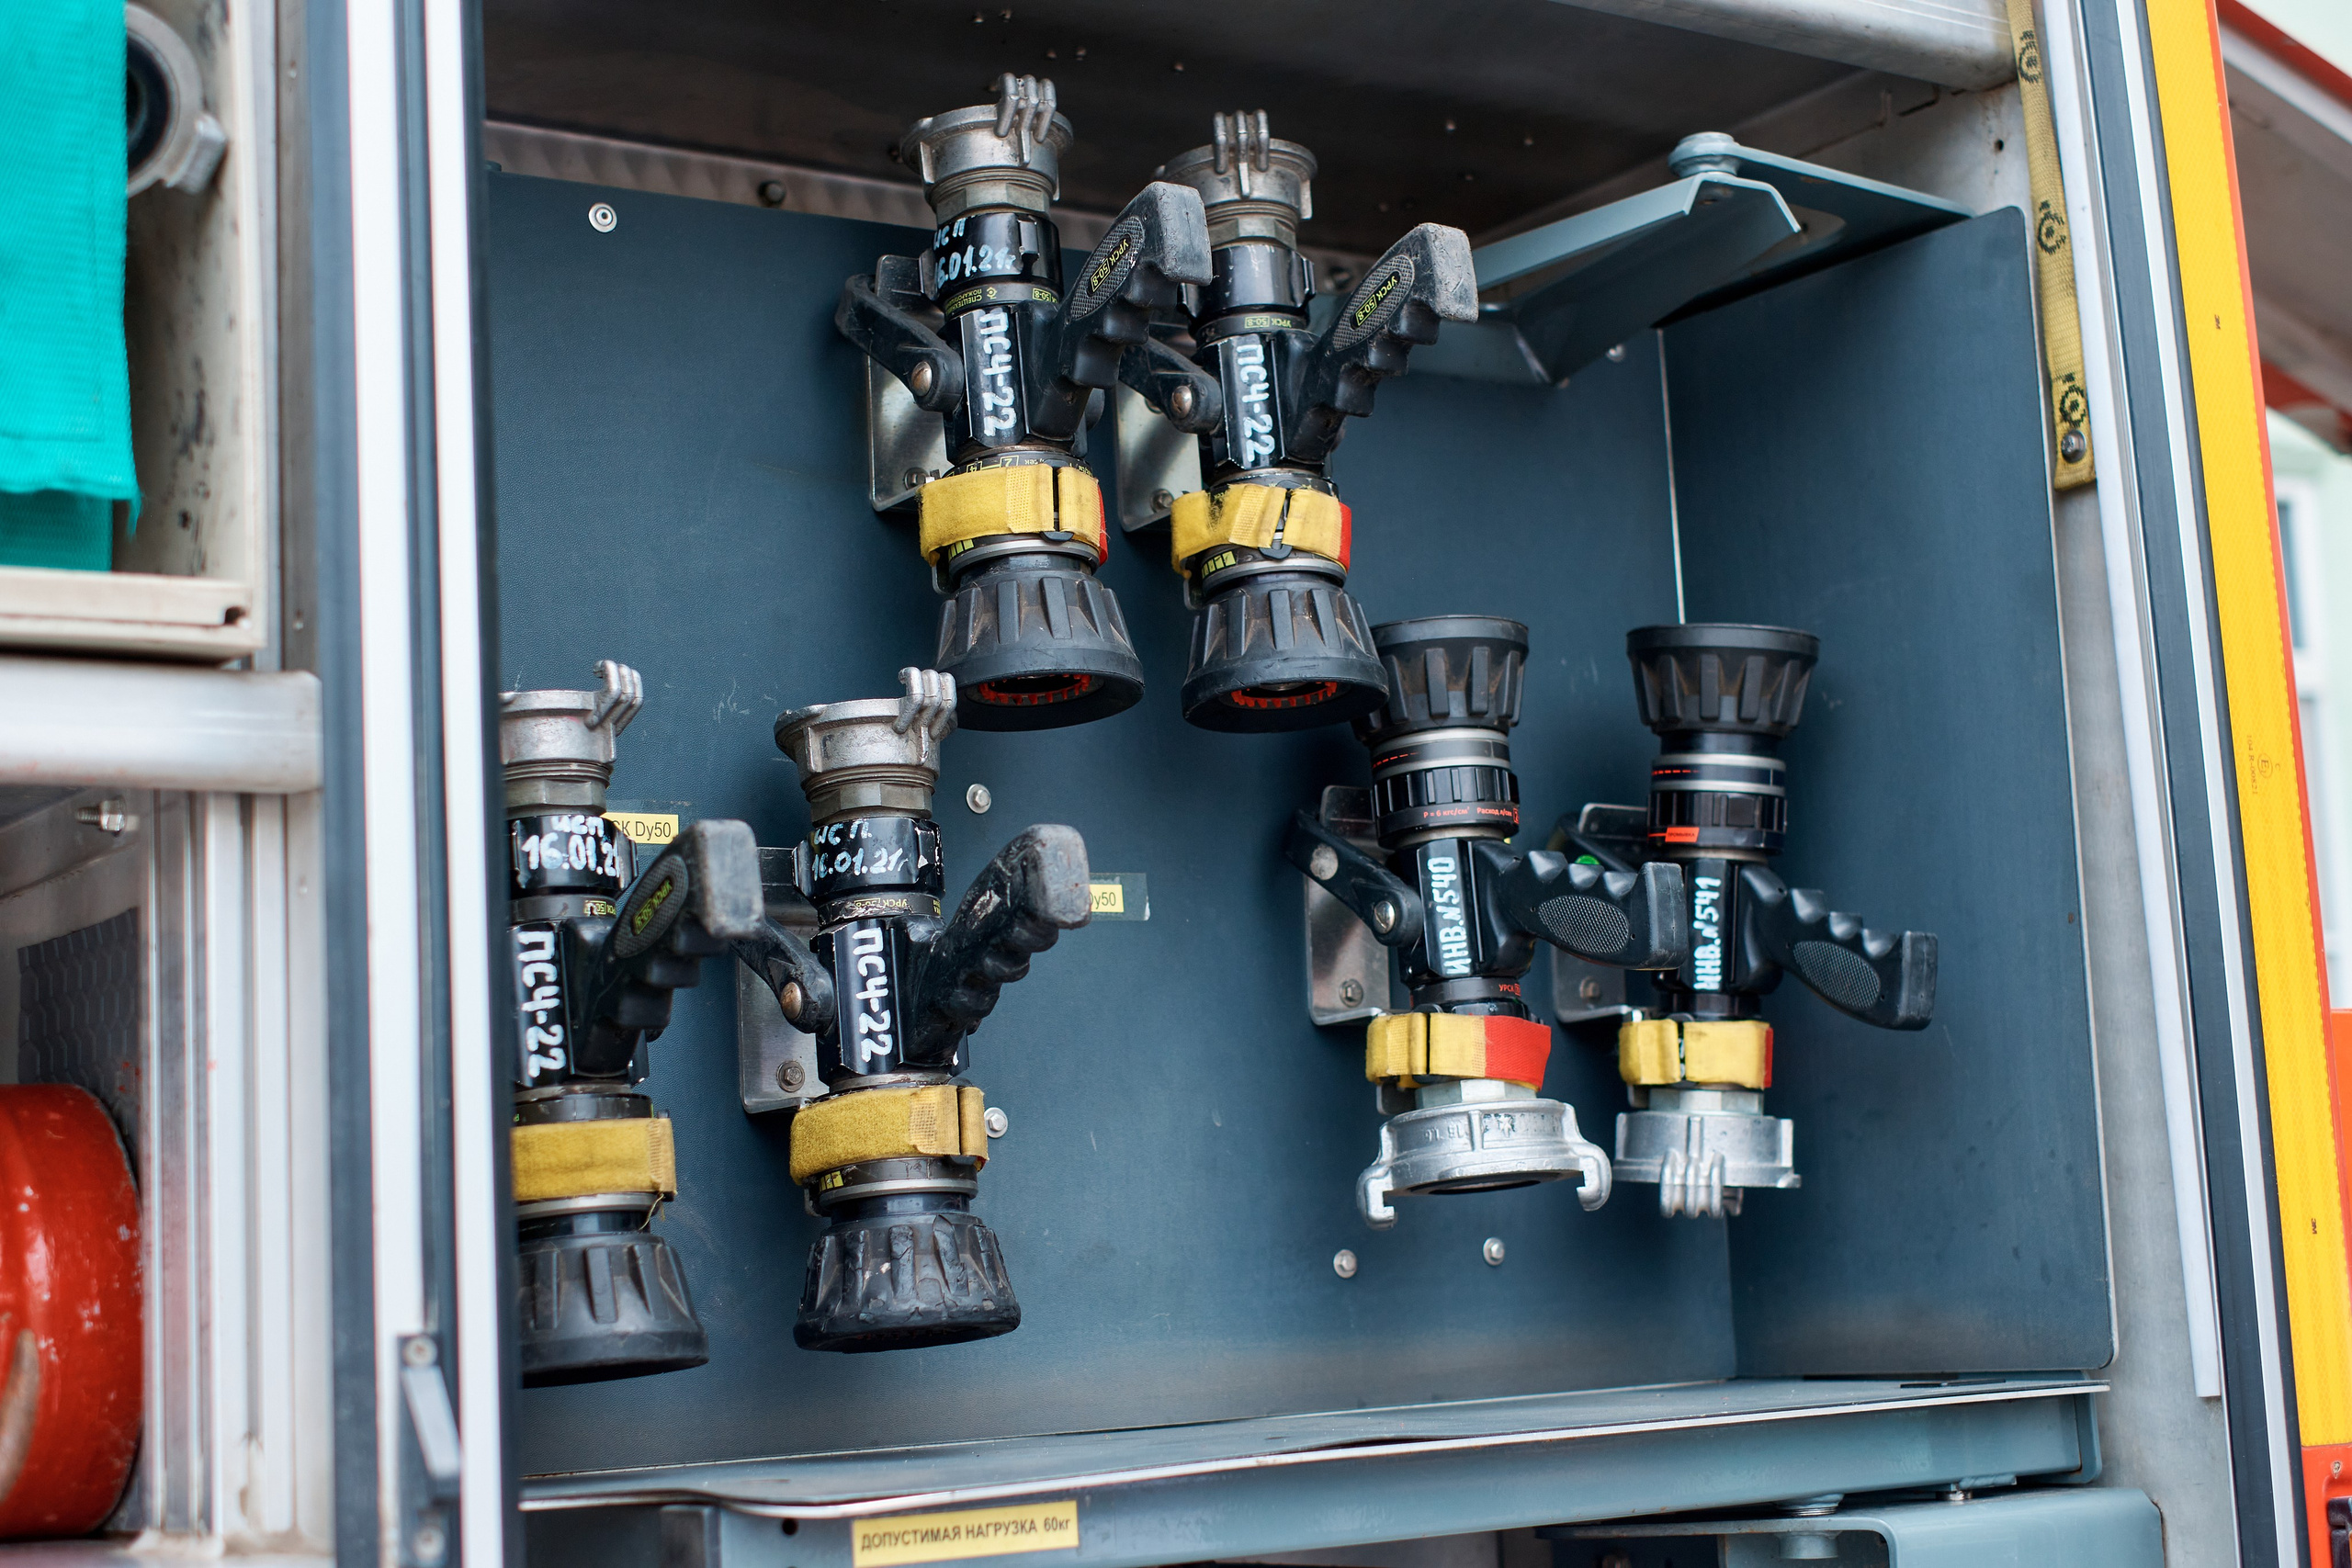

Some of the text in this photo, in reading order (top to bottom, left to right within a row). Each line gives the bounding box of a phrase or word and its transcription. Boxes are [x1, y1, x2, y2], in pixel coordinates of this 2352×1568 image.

[1092, 239, 1129, 287] УРСК 50-8
[1358, 276, 1398, 321] УРСК 50-8
[1247, 318, 1292, 328] УРСК 50-8
[881, 898, 908, 908] УРСК
[861, 1525, 962, 1552] ДОПУСТИМАЯ
[966, 1518, 1037, 1540] НАГРУЗКА
